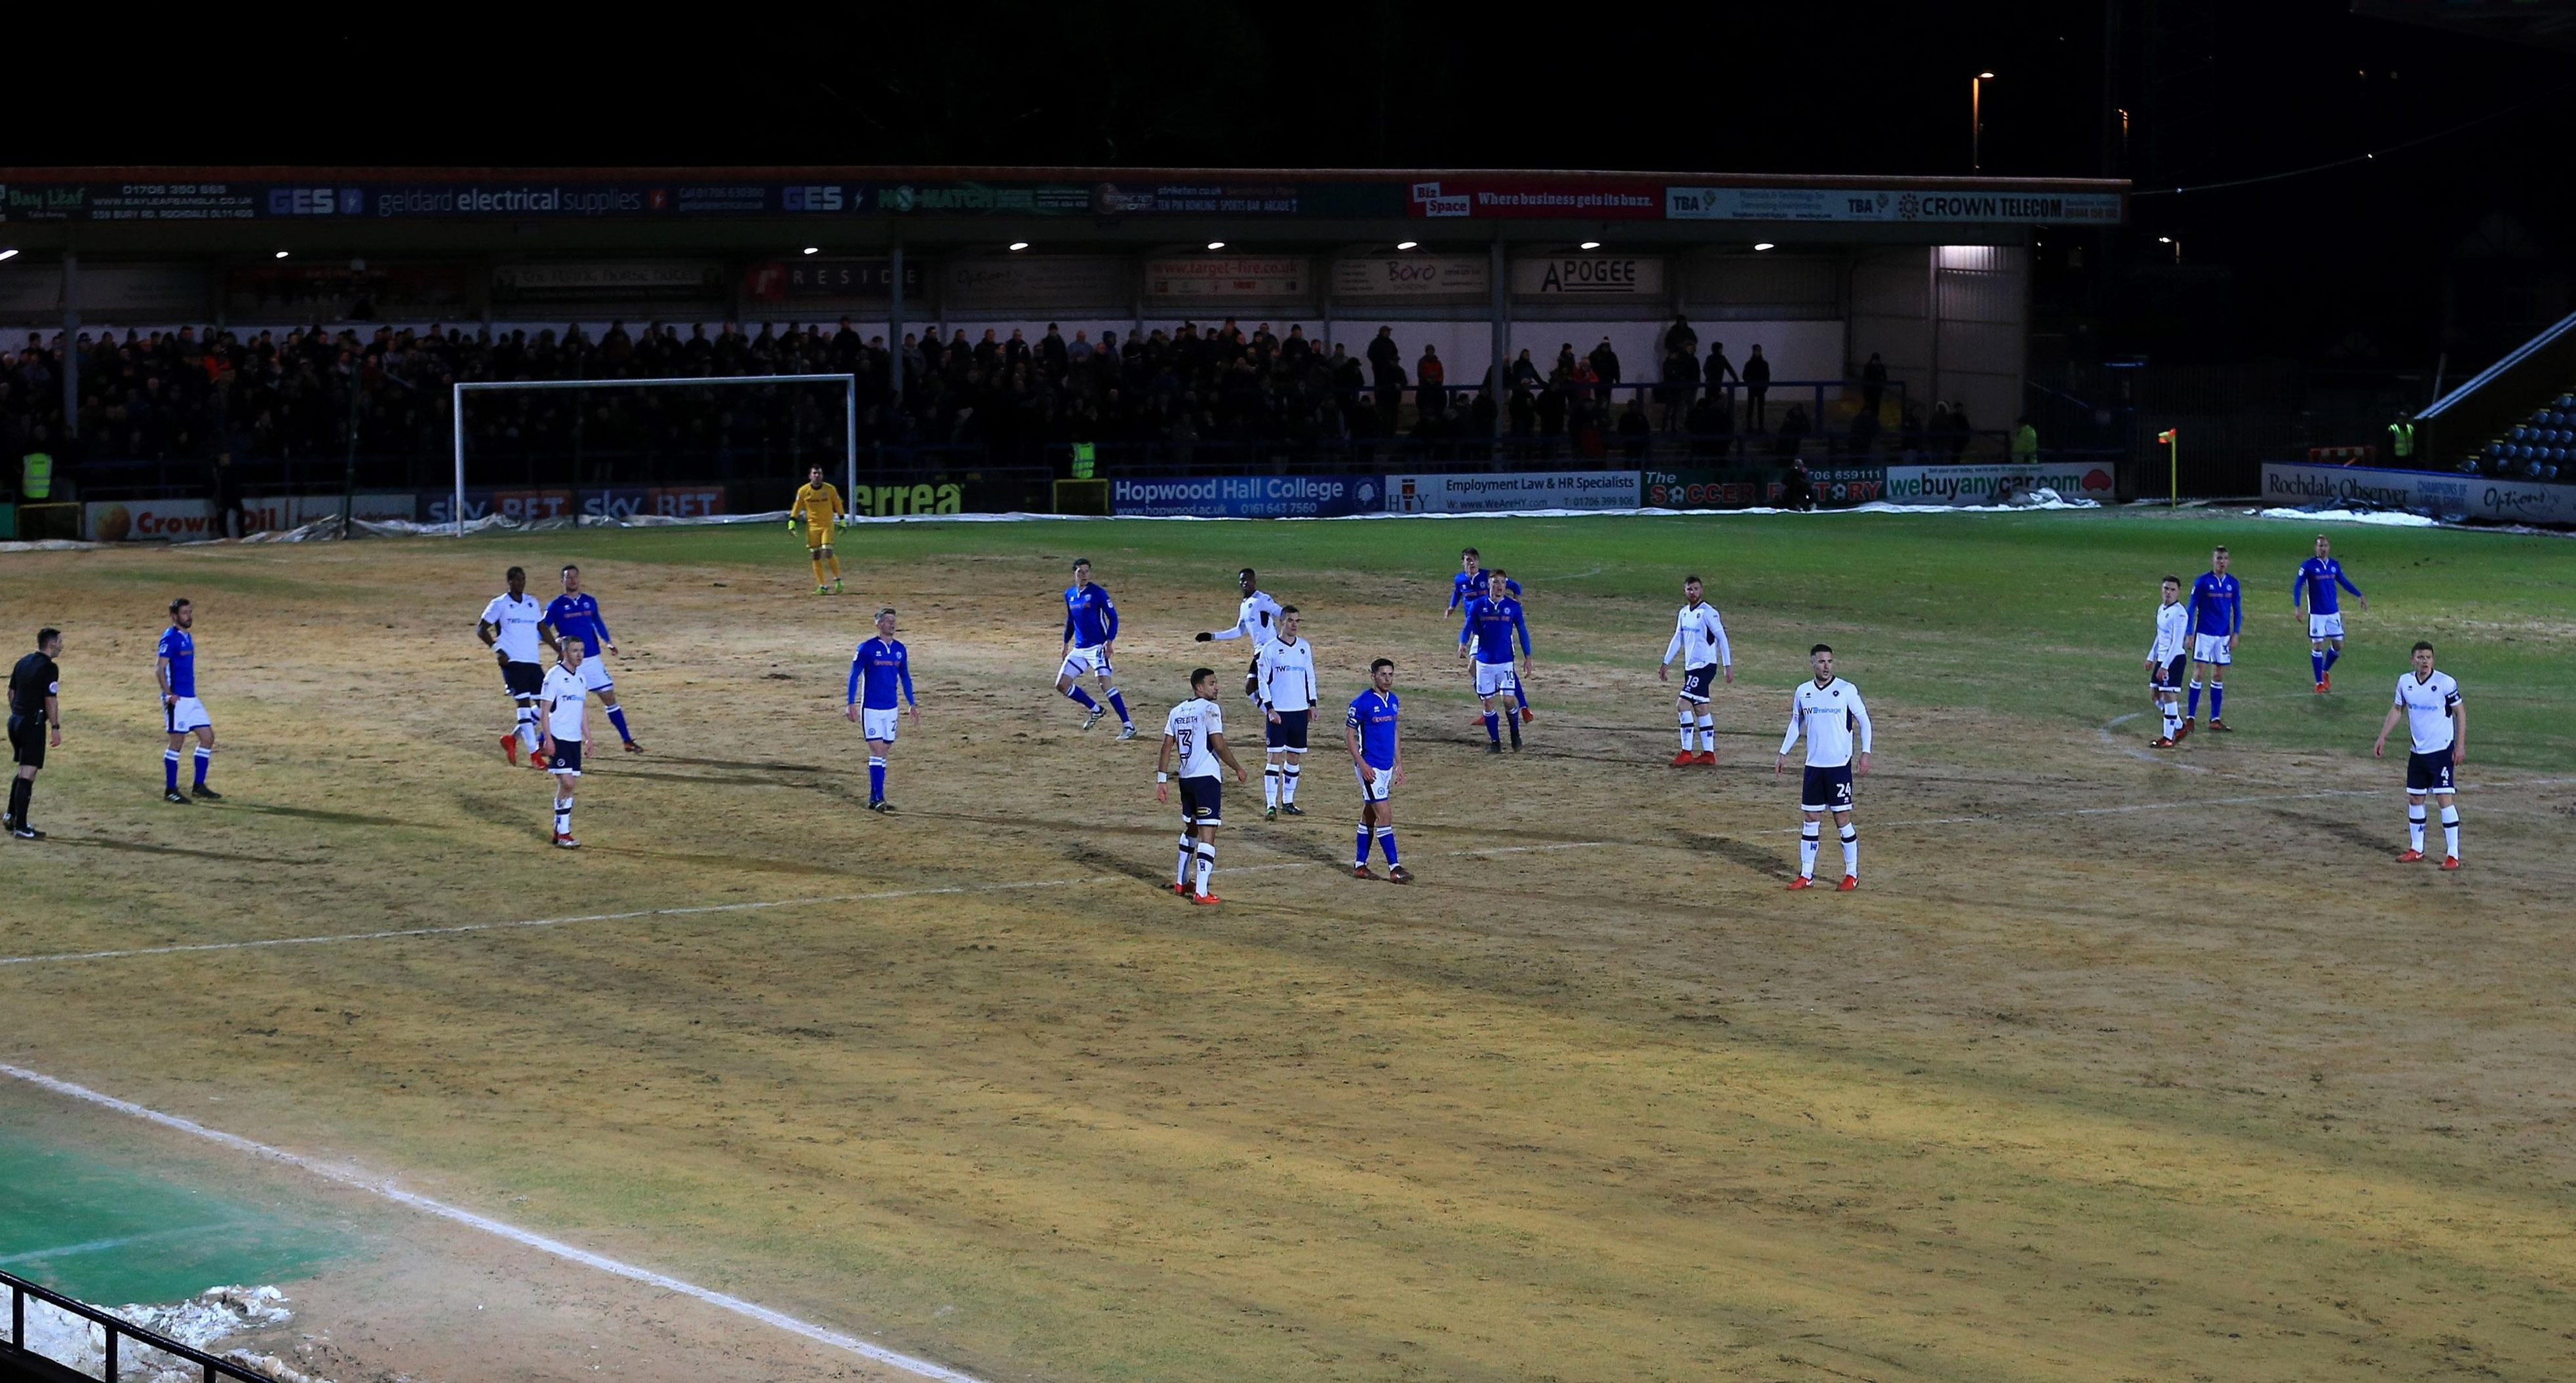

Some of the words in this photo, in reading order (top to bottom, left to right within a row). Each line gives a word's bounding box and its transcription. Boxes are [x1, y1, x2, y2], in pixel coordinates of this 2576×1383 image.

[268, 188, 336, 214] GES
[378, 189, 452, 216] geldard
[458, 187, 560, 210] electrical
[563, 188, 641, 215] supplies
[782, 186, 843, 210] GES
[1418, 187, 1437, 198] Biz
[1478, 192, 1519, 205] Where
[1520, 192, 1575, 205] business
[1576, 194, 1602, 208] gets
[1604, 193, 1620, 206] its
[1429, 201, 1468, 214] Space
[1673, 196, 1700, 211] TBA
[1848, 199, 1873, 214] TBA
[1922, 197, 1996, 216] CROWN
[2000, 199, 2062, 217] TELECOM
[1540, 260, 1635, 292] APOGEE
[1646, 471, 1677, 484] The
[1835, 470, 1881, 479] 659111
[1116, 479, 1217, 503] Hopwood
[1223, 478, 1260, 498] Hall
[1267, 478, 1344, 501] College
[1446, 478, 1518, 496] Employment
[1521, 478, 1544, 490] Law
[1546, 478, 1555, 489] &
[1558, 477, 1574, 488] HR
[1577, 476, 1634, 491] Specialists
[1889, 473, 2081, 500] webuyanycarcom
[2268, 473, 2337, 497] Rochdale
[2339, 478, 2410, 503] Observer
[503, 497, 564, 518] BET
[585, 490, 642, 518] sky
[657, 494, 716, 517] BET
[1116, 503, 1227, 516] www.hopwood.ac.uk
[1241, 503, 1264, 514] 0161
[1266, 503, 1287, 513] 643
[1573, 497, 1599, 506] 01706
[137, 511, 218, 533] Crown
[1504, 670, 1515, 681] 10
[1687, 674, 1699, 688] 18
[1177, 729, 1192, 758] 3
[2440, 766, 2449, 780] 4
[1836, 783, 1852, 798] 24
